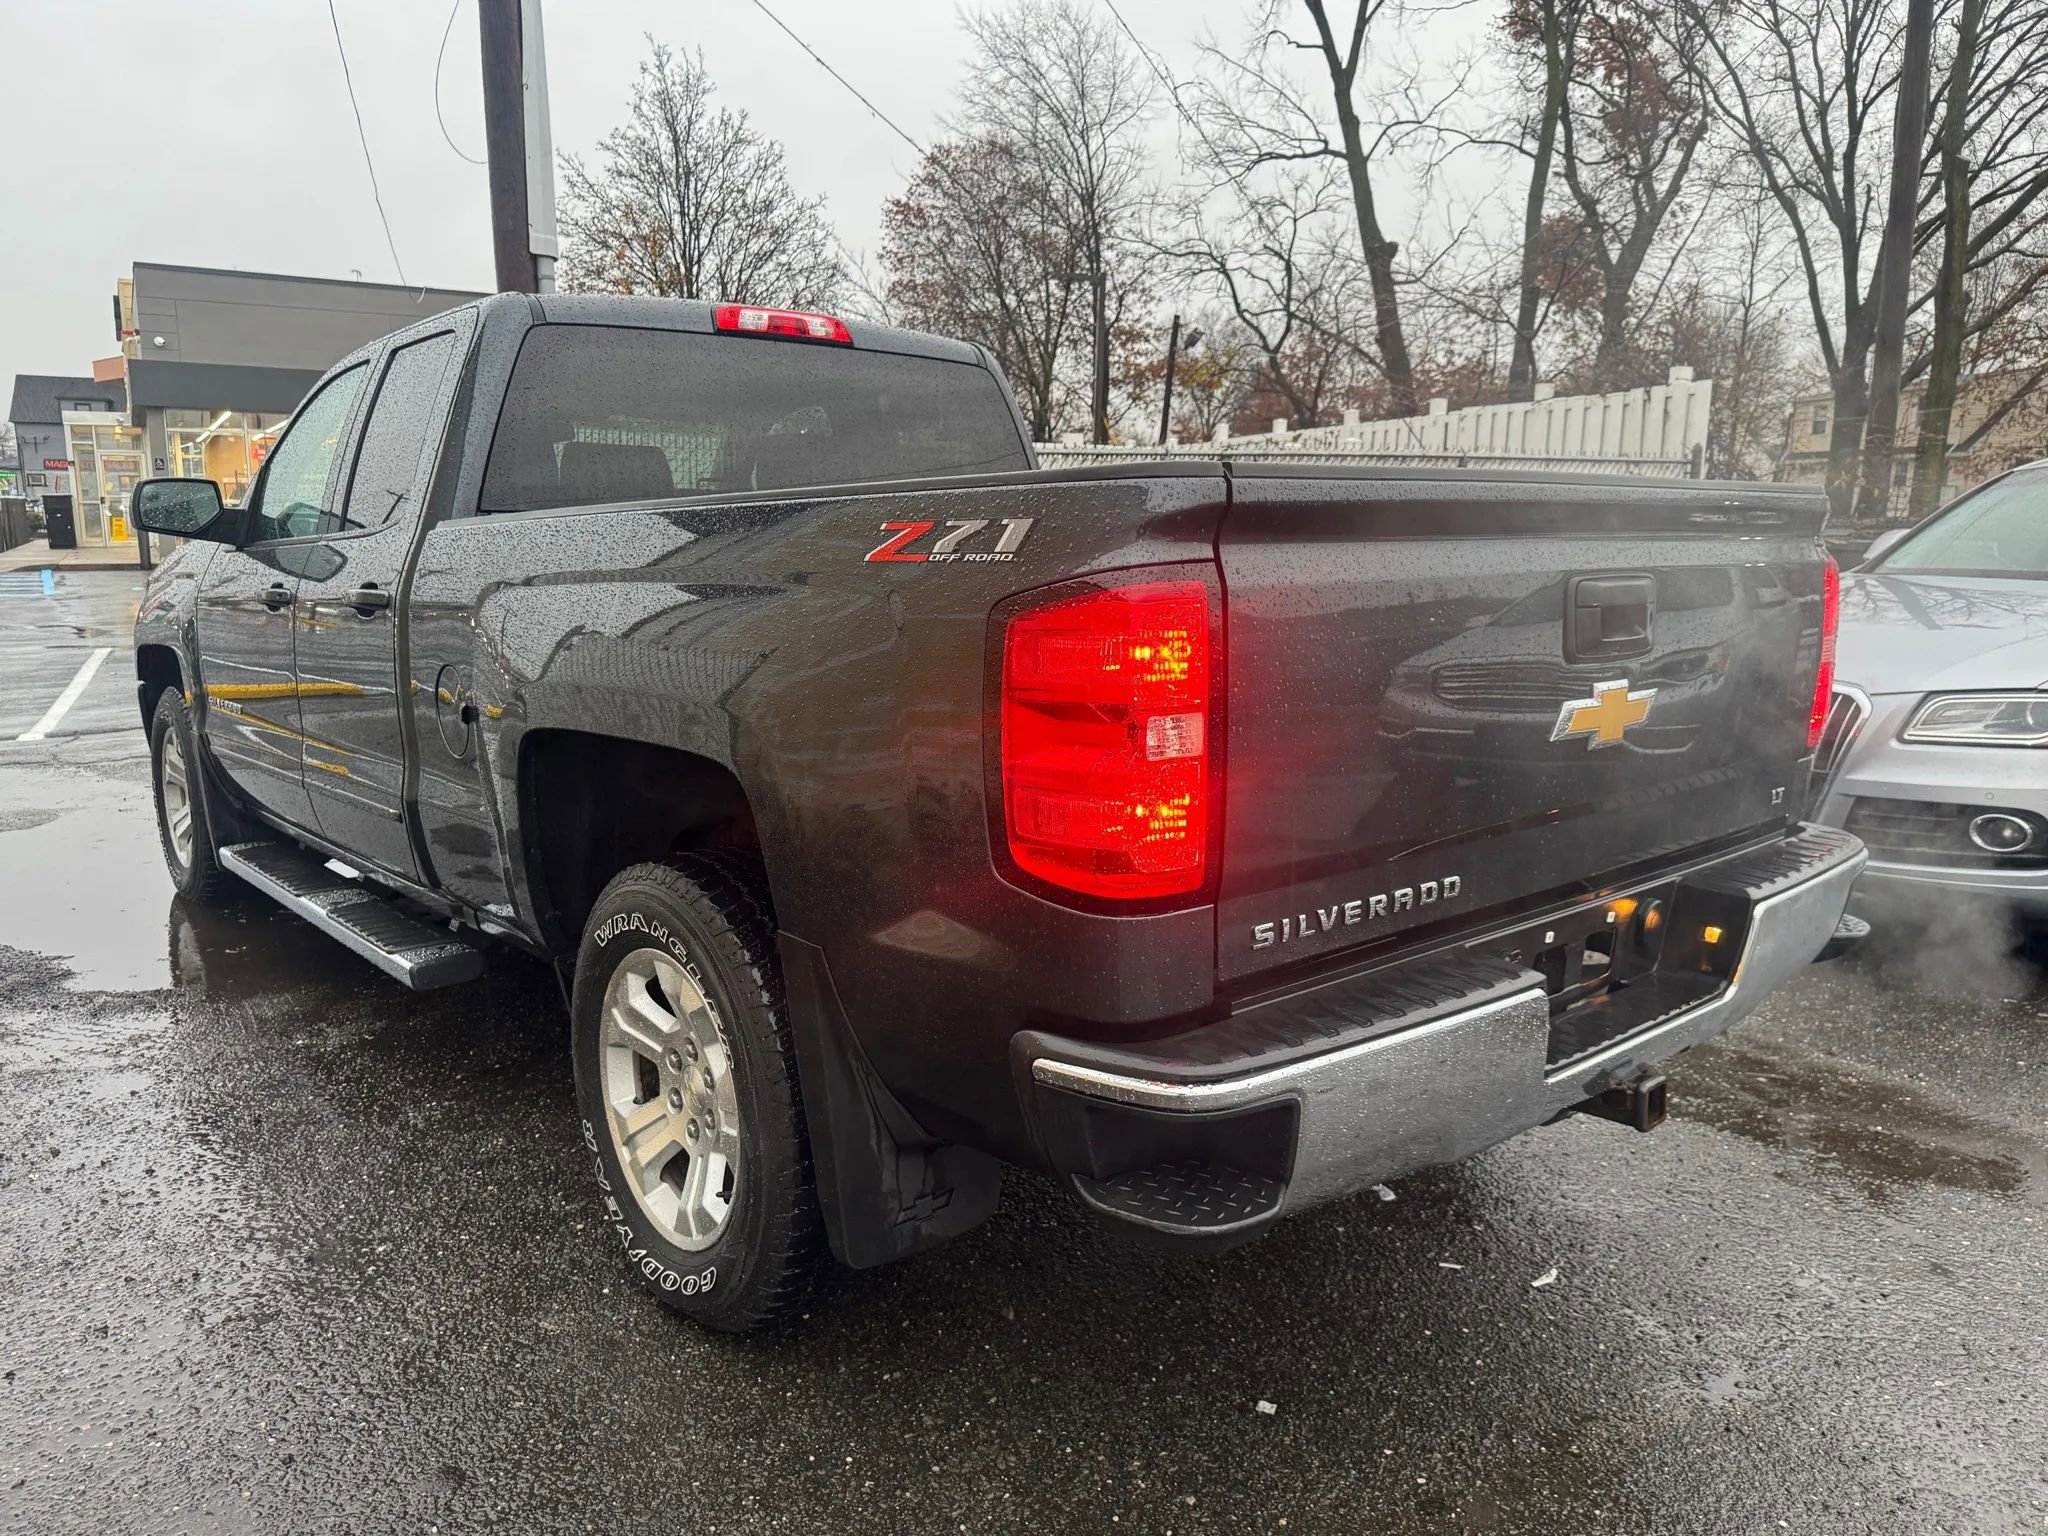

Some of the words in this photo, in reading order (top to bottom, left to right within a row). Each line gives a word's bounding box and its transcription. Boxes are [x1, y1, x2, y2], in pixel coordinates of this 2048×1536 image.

[864, 519, 1034, 562] Z71
[928, 553, 960, 562] OFF
[963, 553, 1014, 562] ROAD
[1771, 787, 1785, 805] LT
[1252, 875, 1462, 950] SILVERADO
[594, 913, 735, 1069] WRANGLER
[582, 1119, 717, 1295] GOODYEAR
